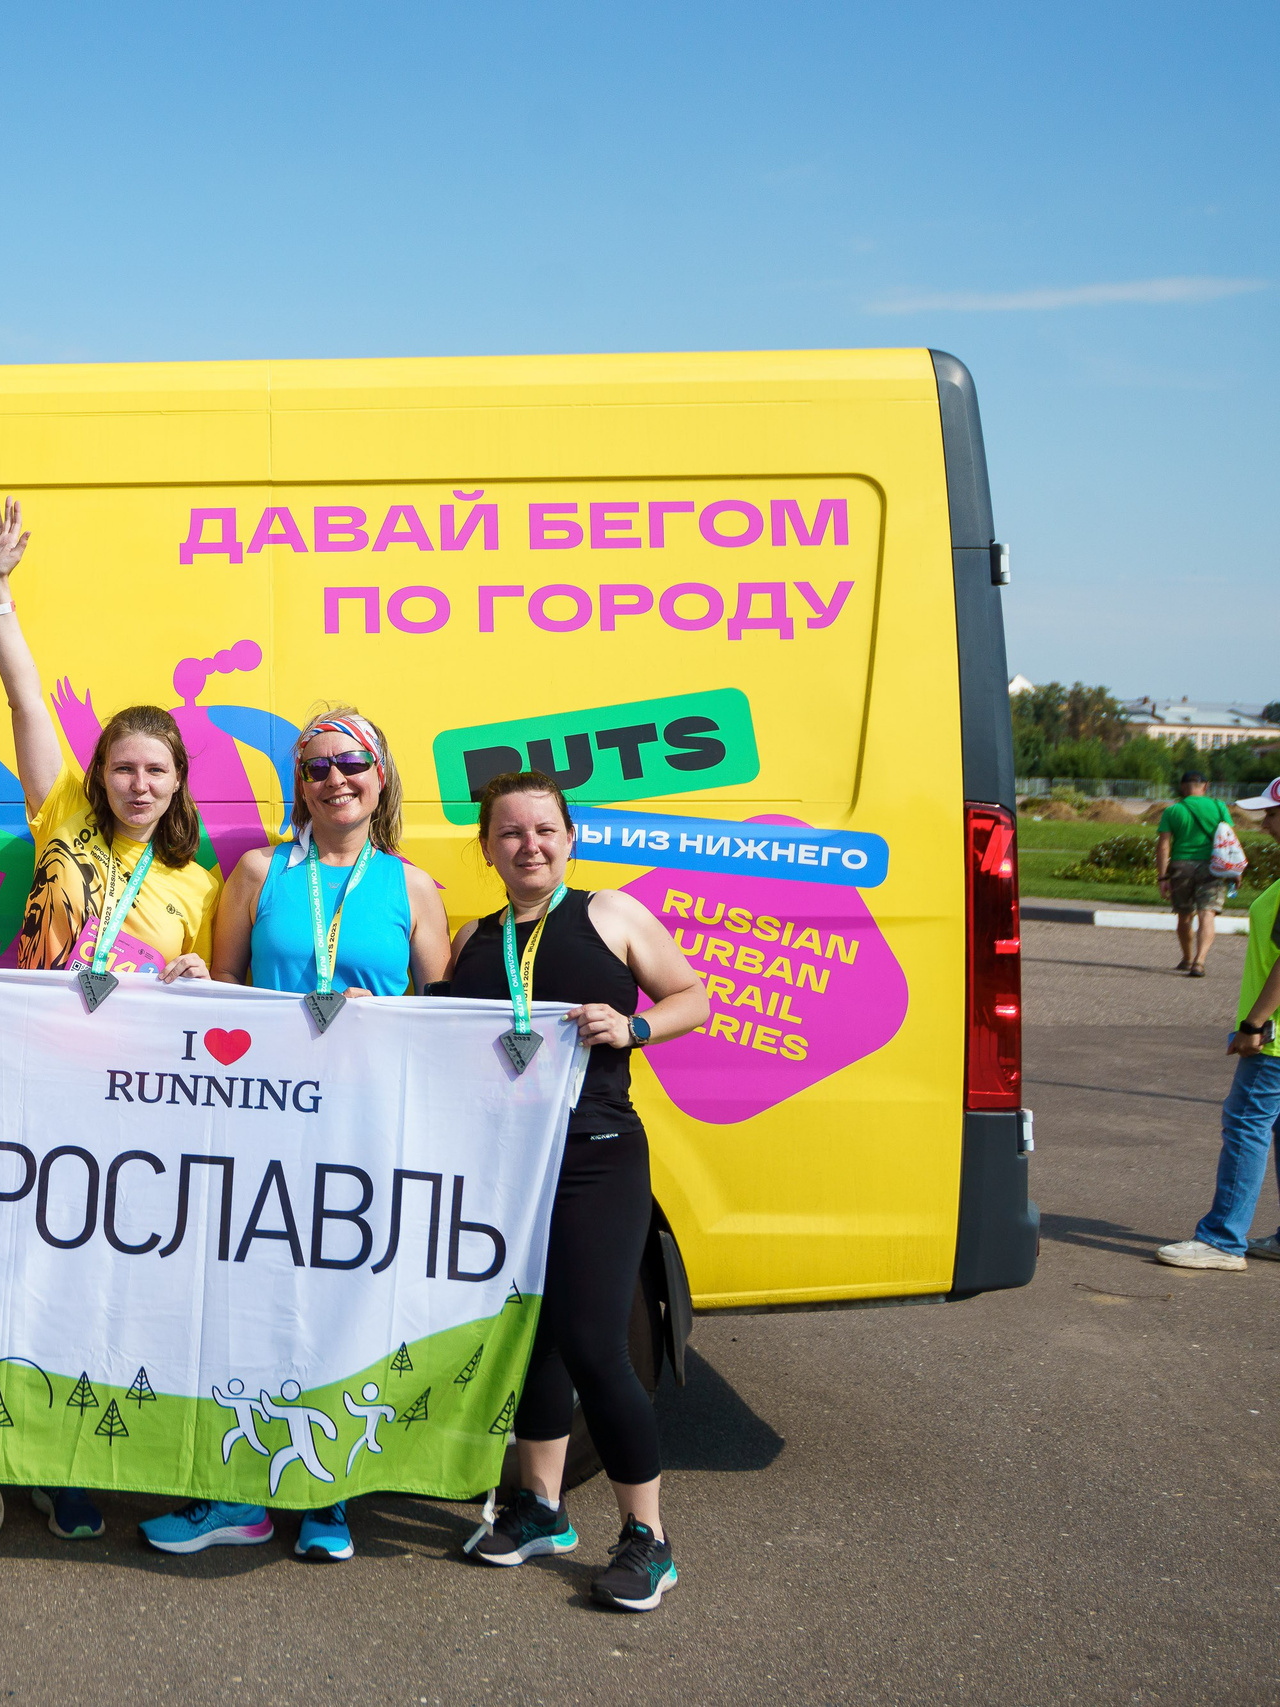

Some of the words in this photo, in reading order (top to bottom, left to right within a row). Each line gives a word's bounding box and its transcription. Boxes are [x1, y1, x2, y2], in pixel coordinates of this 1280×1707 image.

[180, 490, 500, 565] ДАВАЙ
[528, 499, 850, 551] БЕГОМ
[324, 586, 451, 634] ПО
[478, 580, 855, 641] ГОРОДУ
[463, 716, 726, 802] RUTS
[573, 823, 612, 846] Ы
[621, 828, 670, 850] ИЗ
[679, 833, 868, 870] НИЖНЕГО
[312, 886, 319, 897] ПО
[314, 897, 325, 948] ЯРОСЛАВЛЮ
[662, 888, 860, 965] RUSSIAN
[320, 955, 328, 978] RUTS
[507, 944, 519, 987] ЯРОСЛАВЛЮ
[673, 927, 831, 994] URBAN
[515, 995, 525, 1017] RUTS
[519, 1018, 527, 1034] 202
[181, 1030, 198, 1061] I
[693, 1012, 809, 1061] RIES
[105, 1069, 322, 1113] RUNNING
